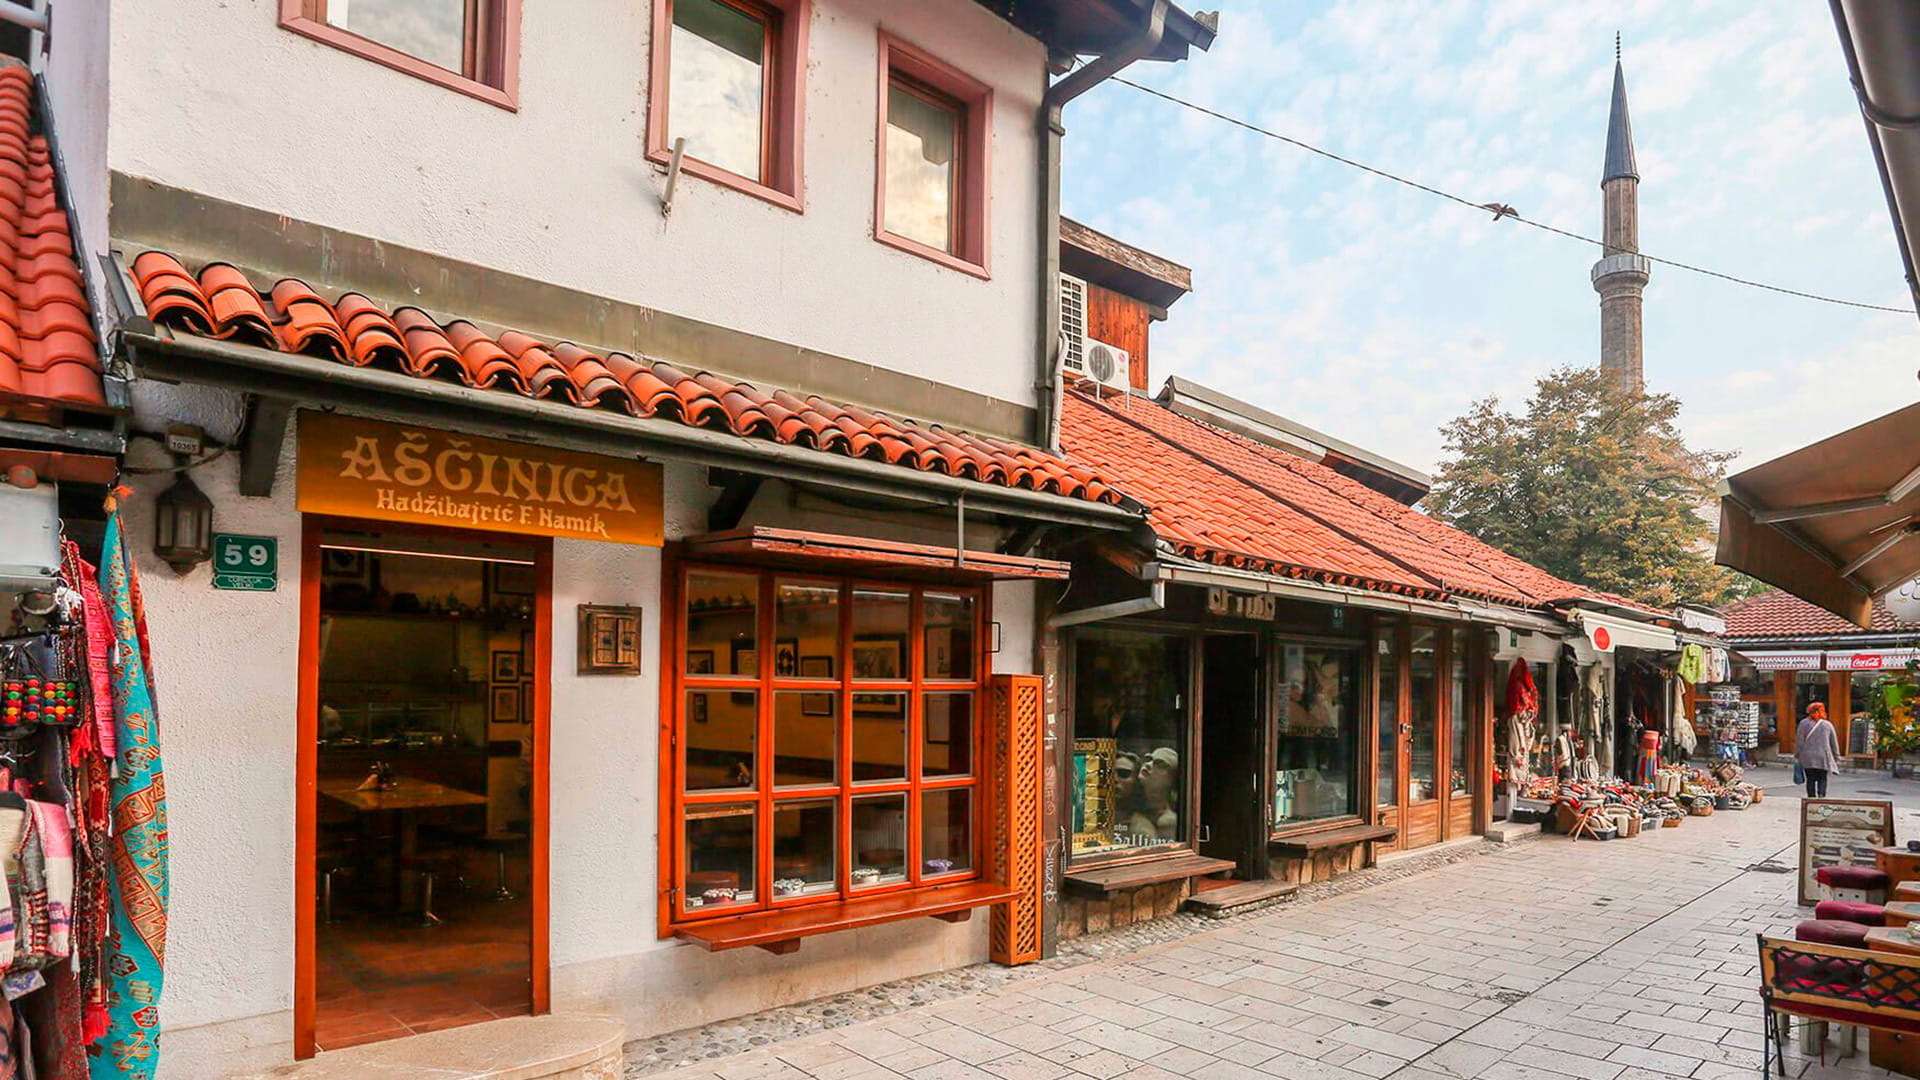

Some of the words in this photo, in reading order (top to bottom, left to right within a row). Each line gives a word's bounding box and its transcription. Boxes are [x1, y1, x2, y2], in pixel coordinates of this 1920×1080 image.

[376, 487, 514, 525] Hadžibajrić
[519, 504, 534, 525] F.
[539, 503, 611, 539] Namik
[224, 544, 268, 566] 59
